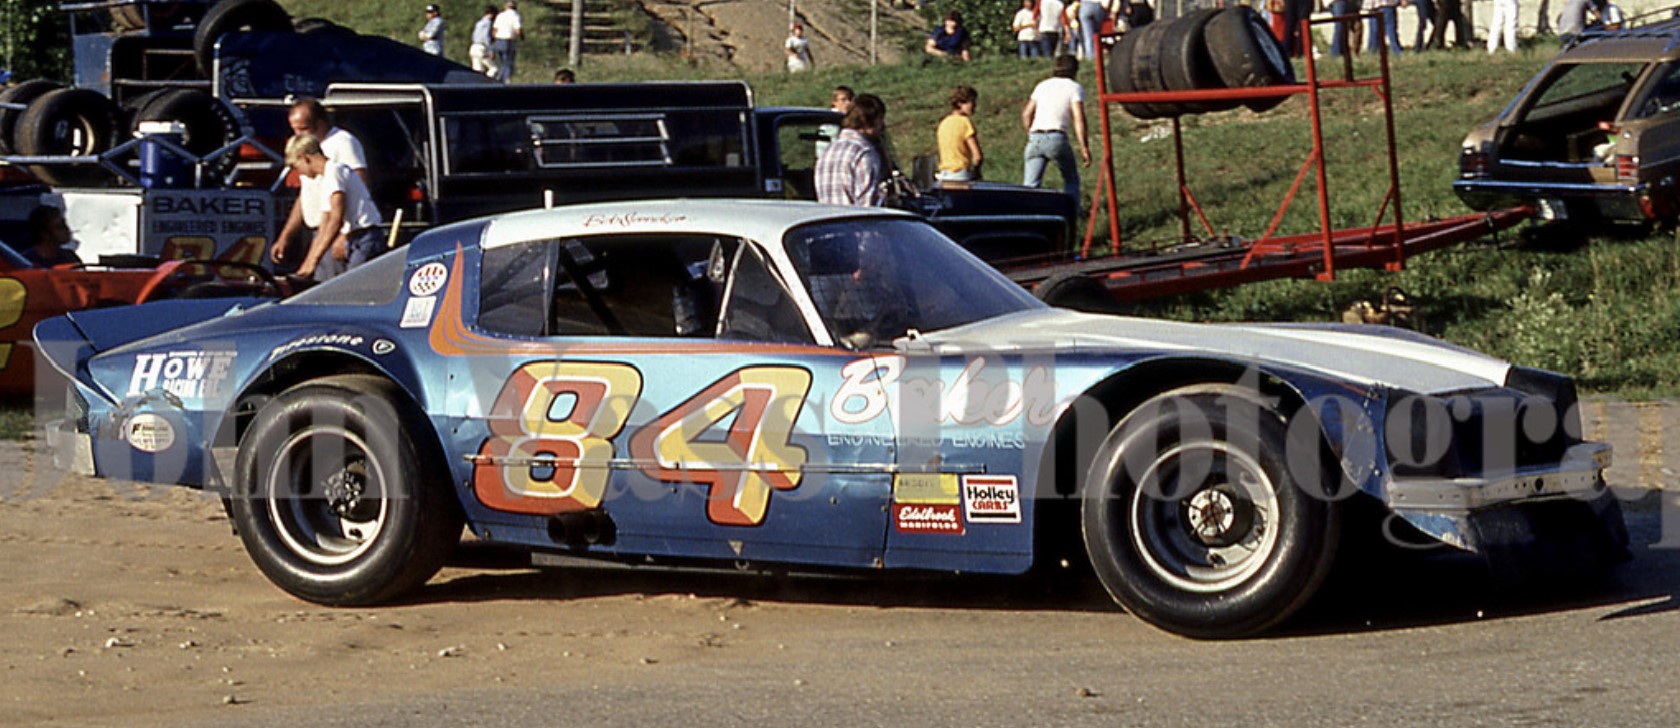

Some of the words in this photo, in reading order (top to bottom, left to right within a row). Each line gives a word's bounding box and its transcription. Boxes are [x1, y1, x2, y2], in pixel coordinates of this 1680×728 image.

[153, 197, 265, 214] BAKER
[126, 353, 235, 398] HOWE
[830, 354, 1072, 427] Baker
[472, 359, 812, 526] 84
[953, 431, 1026, 449] ENGINES
[967, 486, 1014, 504] Holley
[900, 506, 956, 522] Edelbrock
[972, 501, 1008, 511] CARBS
